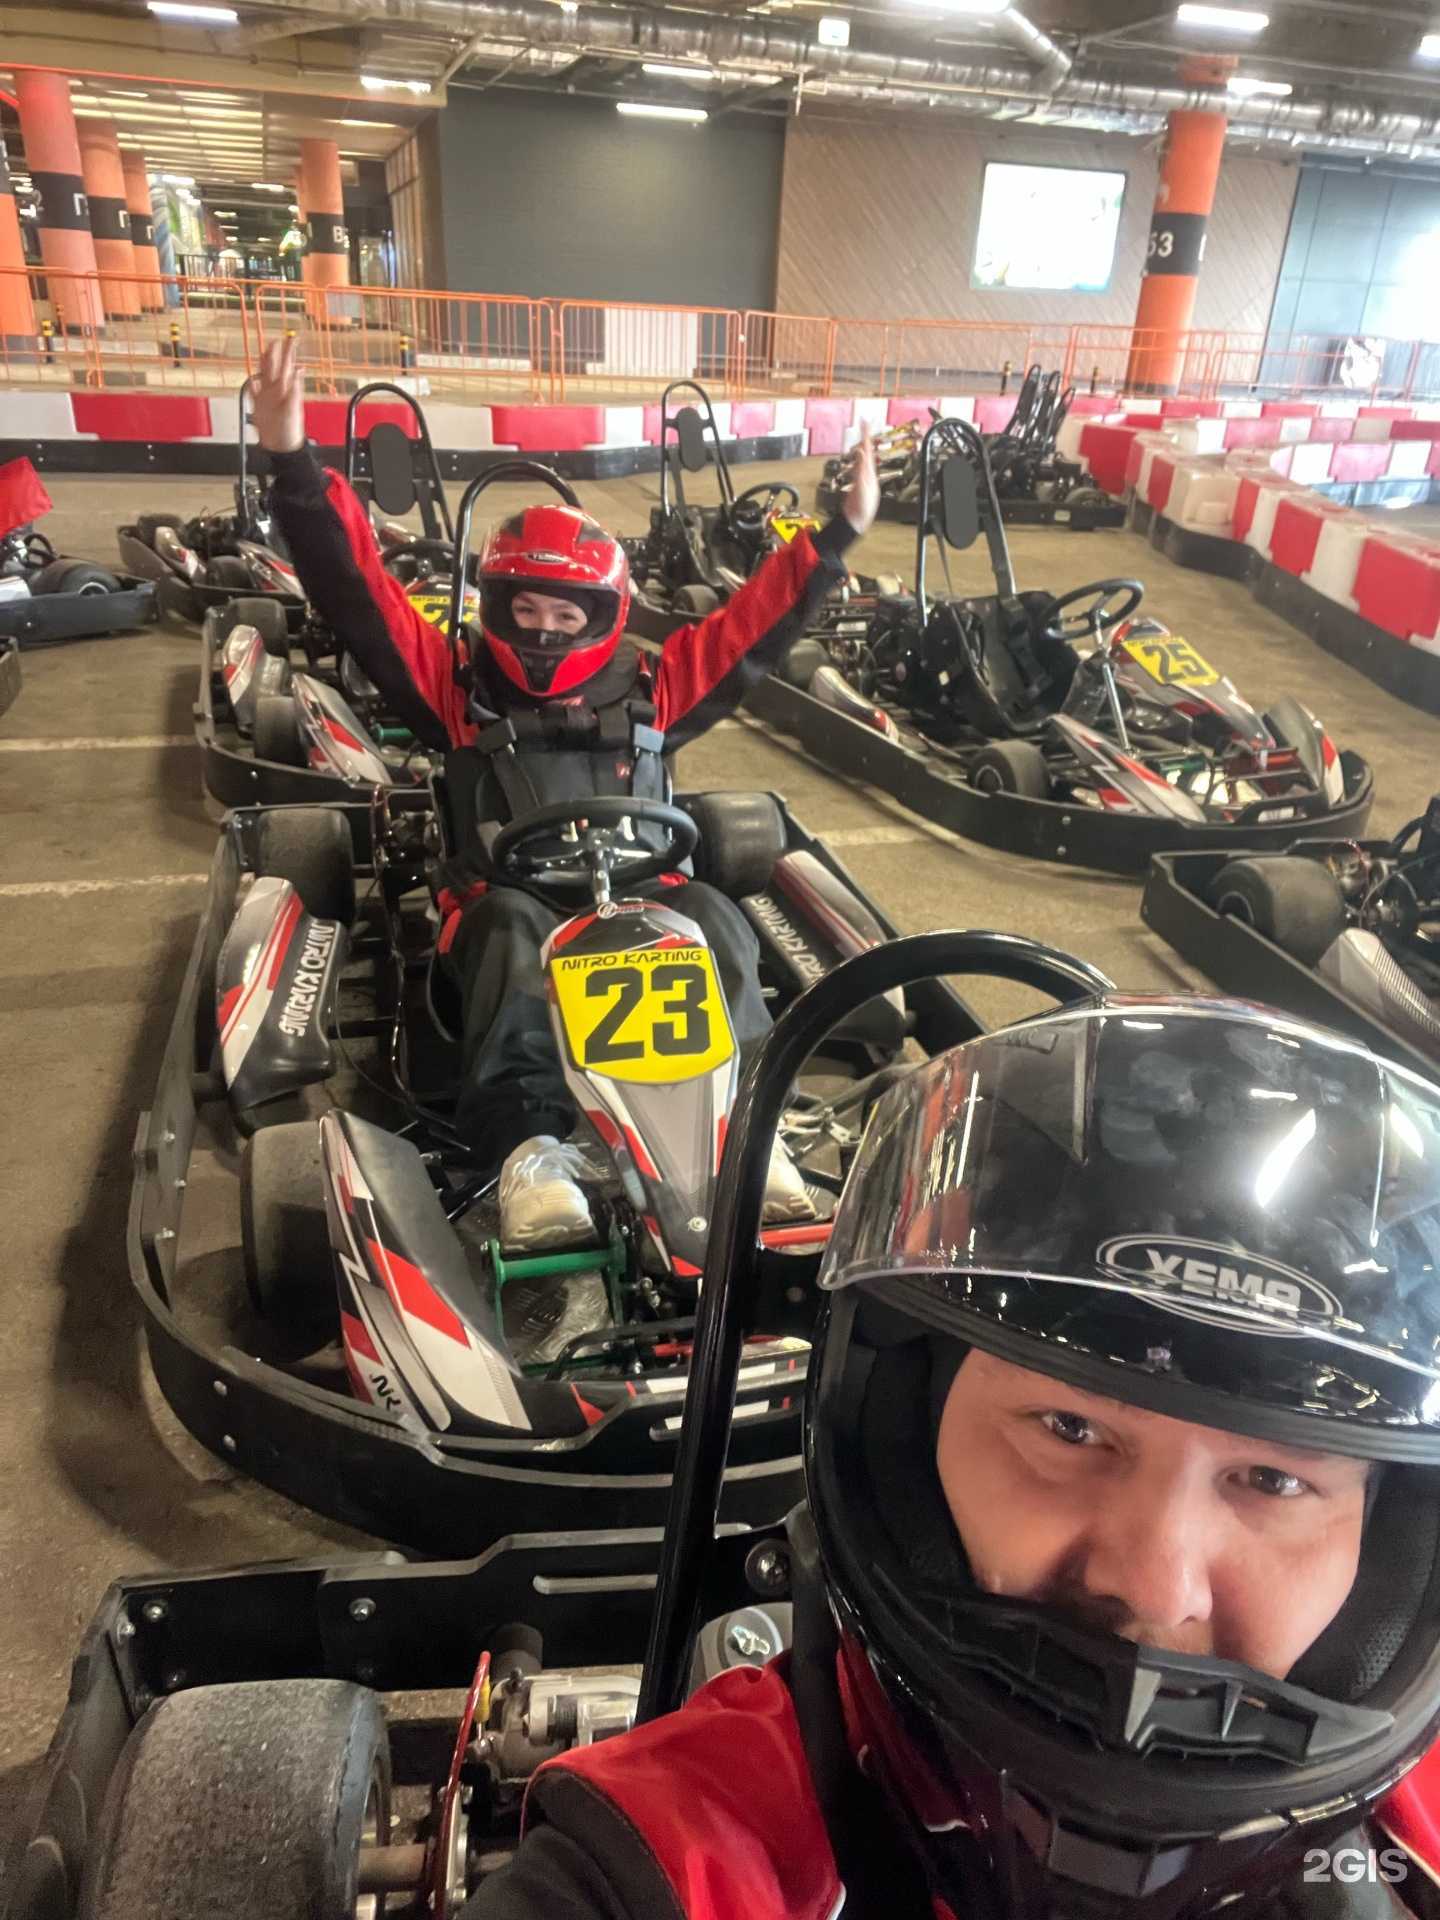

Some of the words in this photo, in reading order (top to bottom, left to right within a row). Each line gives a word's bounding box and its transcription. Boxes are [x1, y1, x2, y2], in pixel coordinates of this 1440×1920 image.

[1142, 643, 1210, 682] 25
[561, 954, 618, 971] NITRO
[623, 950, 702, 965] KARTING
[584, 963, 711, 1065] 23
